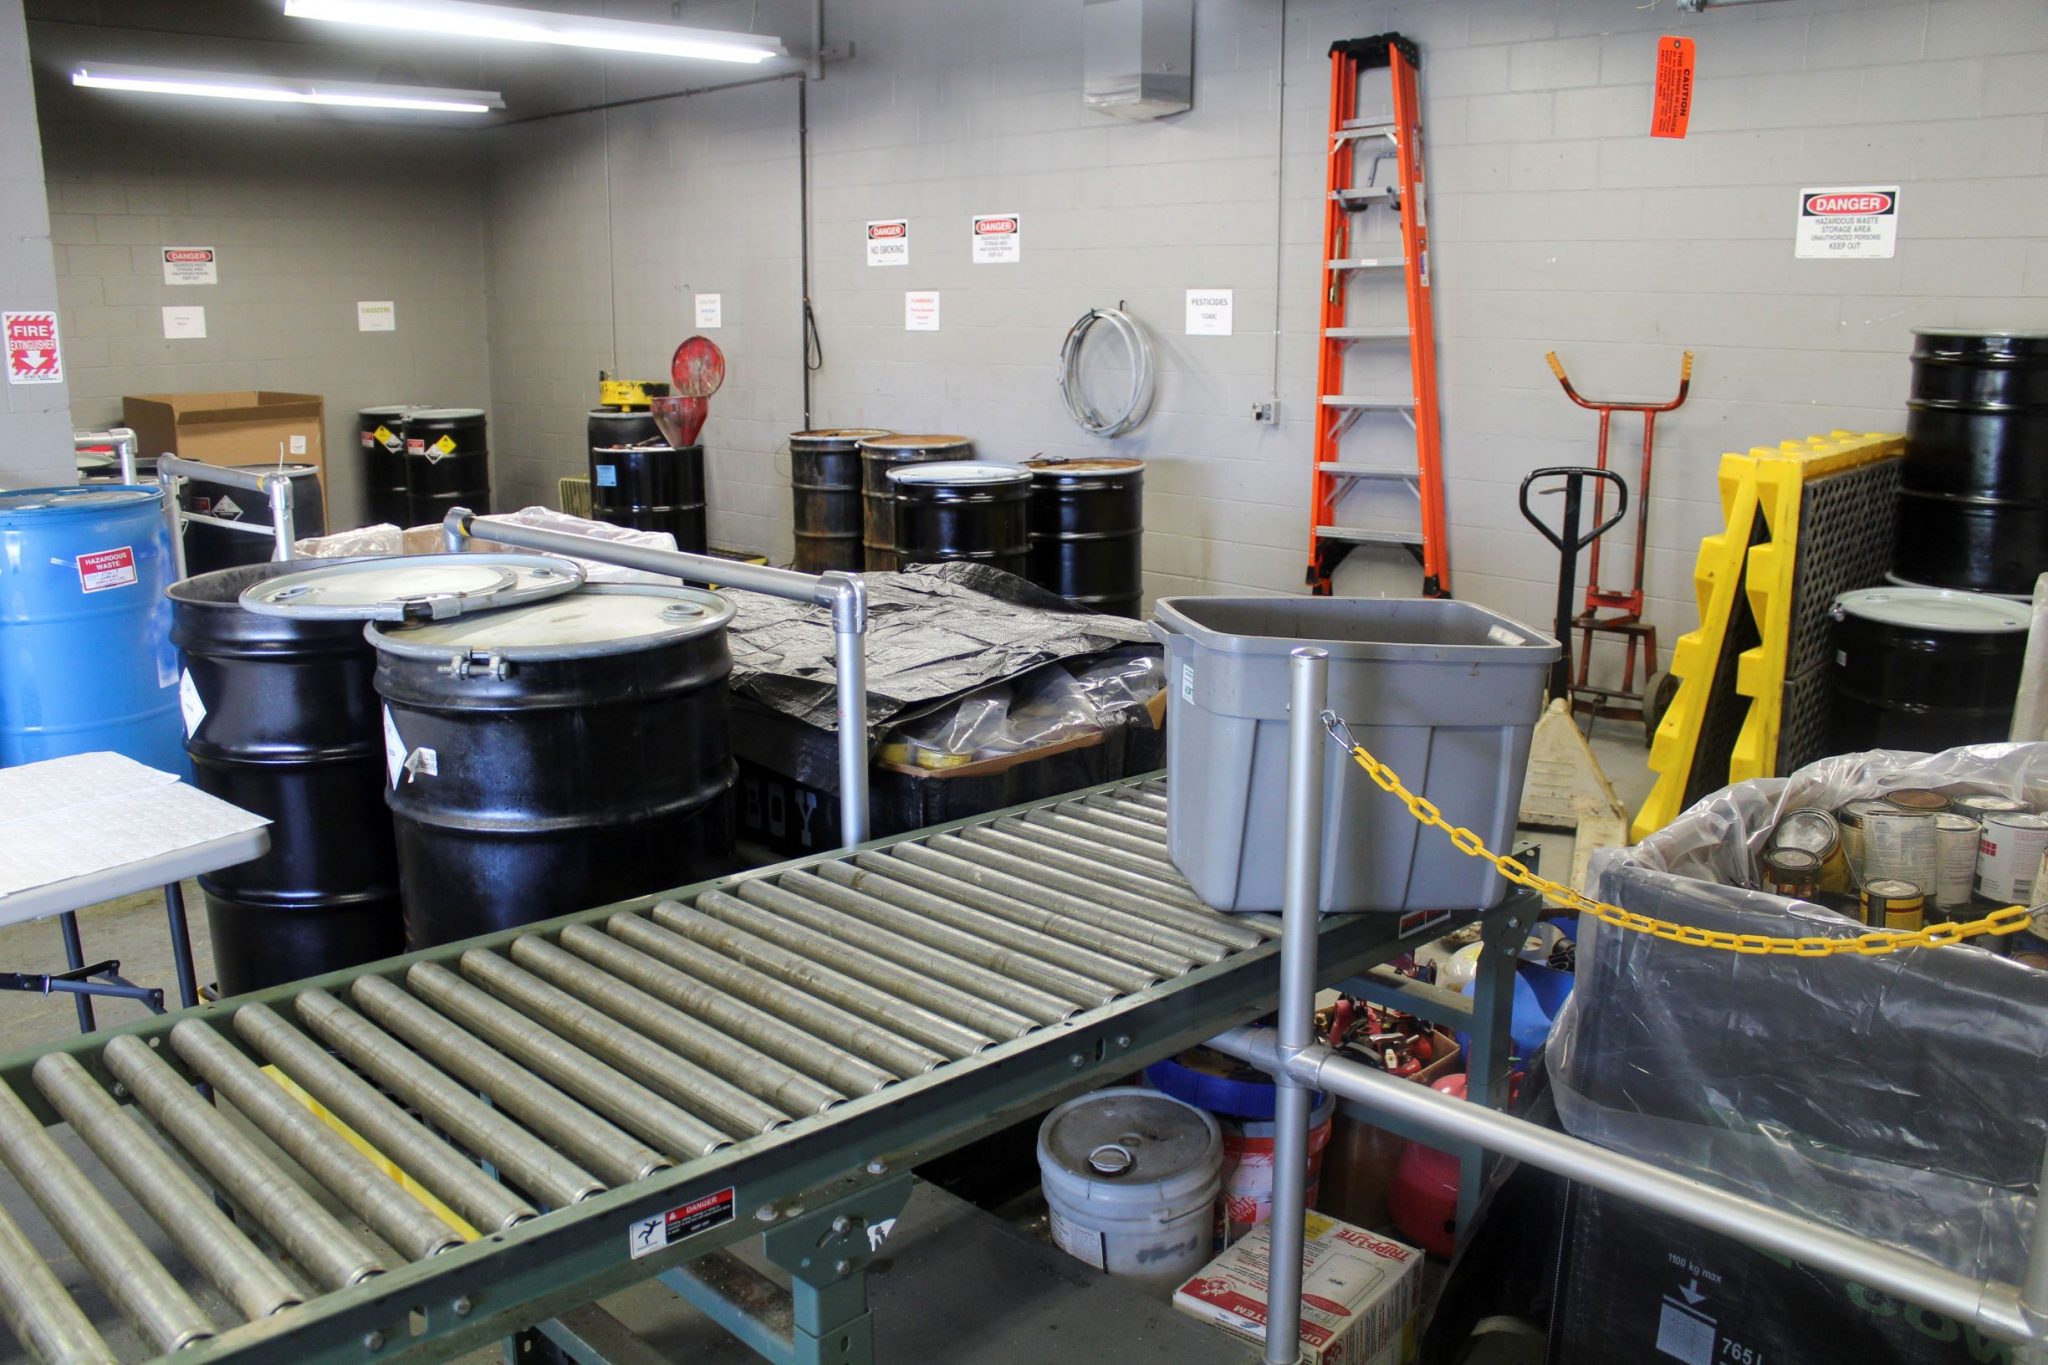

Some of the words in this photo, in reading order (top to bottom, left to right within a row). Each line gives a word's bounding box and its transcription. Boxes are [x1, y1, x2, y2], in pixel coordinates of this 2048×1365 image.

[1679, 68, 1690, 116] CAUTION
[1815, 197, 1880, 211] DANGER
[1815, 217, 1855, 225] HAZARDOUS
[1856, 216, 1879, 225] WASTE
[873, 226, 901, 236] DANGER
[980, 221, 1011, 232] DANGER
[1821, 225, 1852, 233] STORAGE
[1853, 225, 1871, 233] AREA
[1854, 233, 1881, 241] PERSONS
[870, 245, 879, 255] NO
[880, 244, 904, 254] SMOKING
[1828, 242, 1846, 250] KEEP
[1847, 242, 1861, 250] OUT
[171, 252, 206, 260] DANGER
[13, 325, 49, 337] FIRE
[85, 551, 127, 566] HAZARDOUS
[96, 560, 120, 571] WASTE
[685, 1196, 717, 1214] DANGER
[1667, 1252, 1686, 1268] 1100
[1688, 1261, 1700, 1276] kg
[1702, 1269, 1723, 1284] max
[1722, 1336, 1754, 1365] 765
